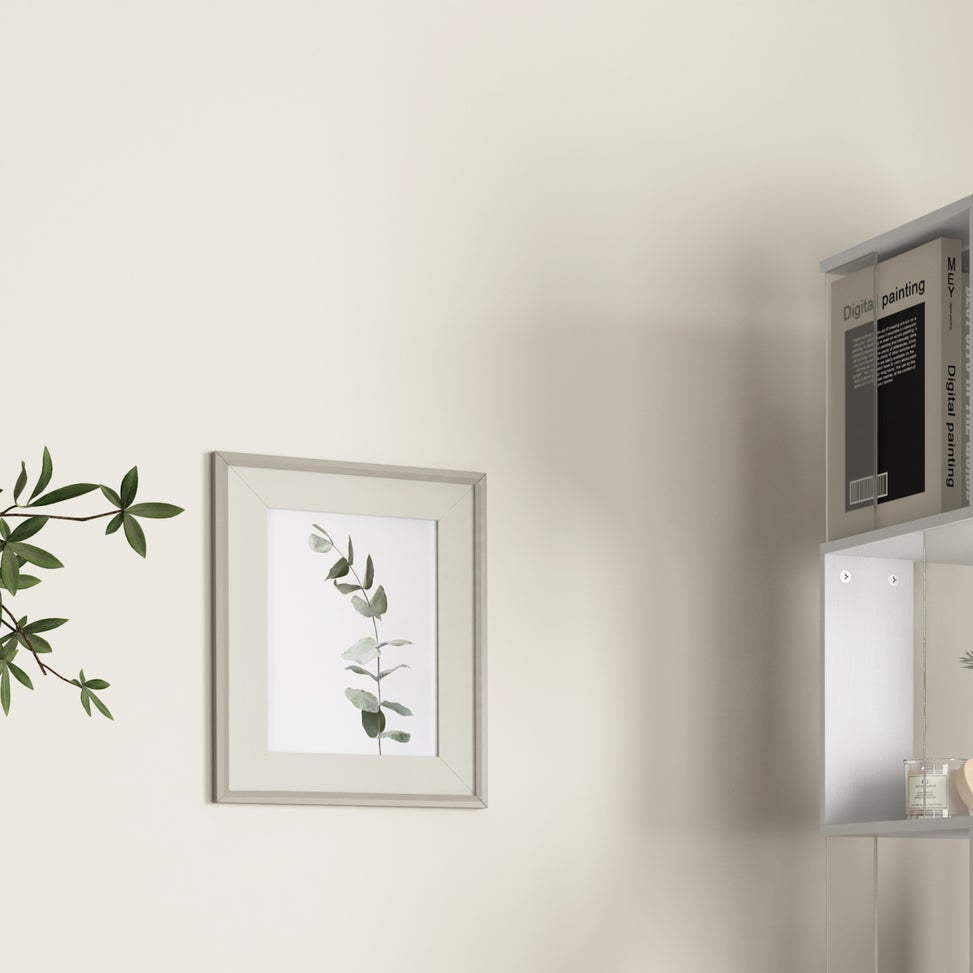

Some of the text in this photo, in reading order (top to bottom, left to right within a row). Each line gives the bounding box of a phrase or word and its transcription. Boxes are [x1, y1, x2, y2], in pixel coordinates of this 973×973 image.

[881, 279, 926, 310] painting
[947, 256, 956, 299] MEY
[945, 365, 956, 488] Digital painting
